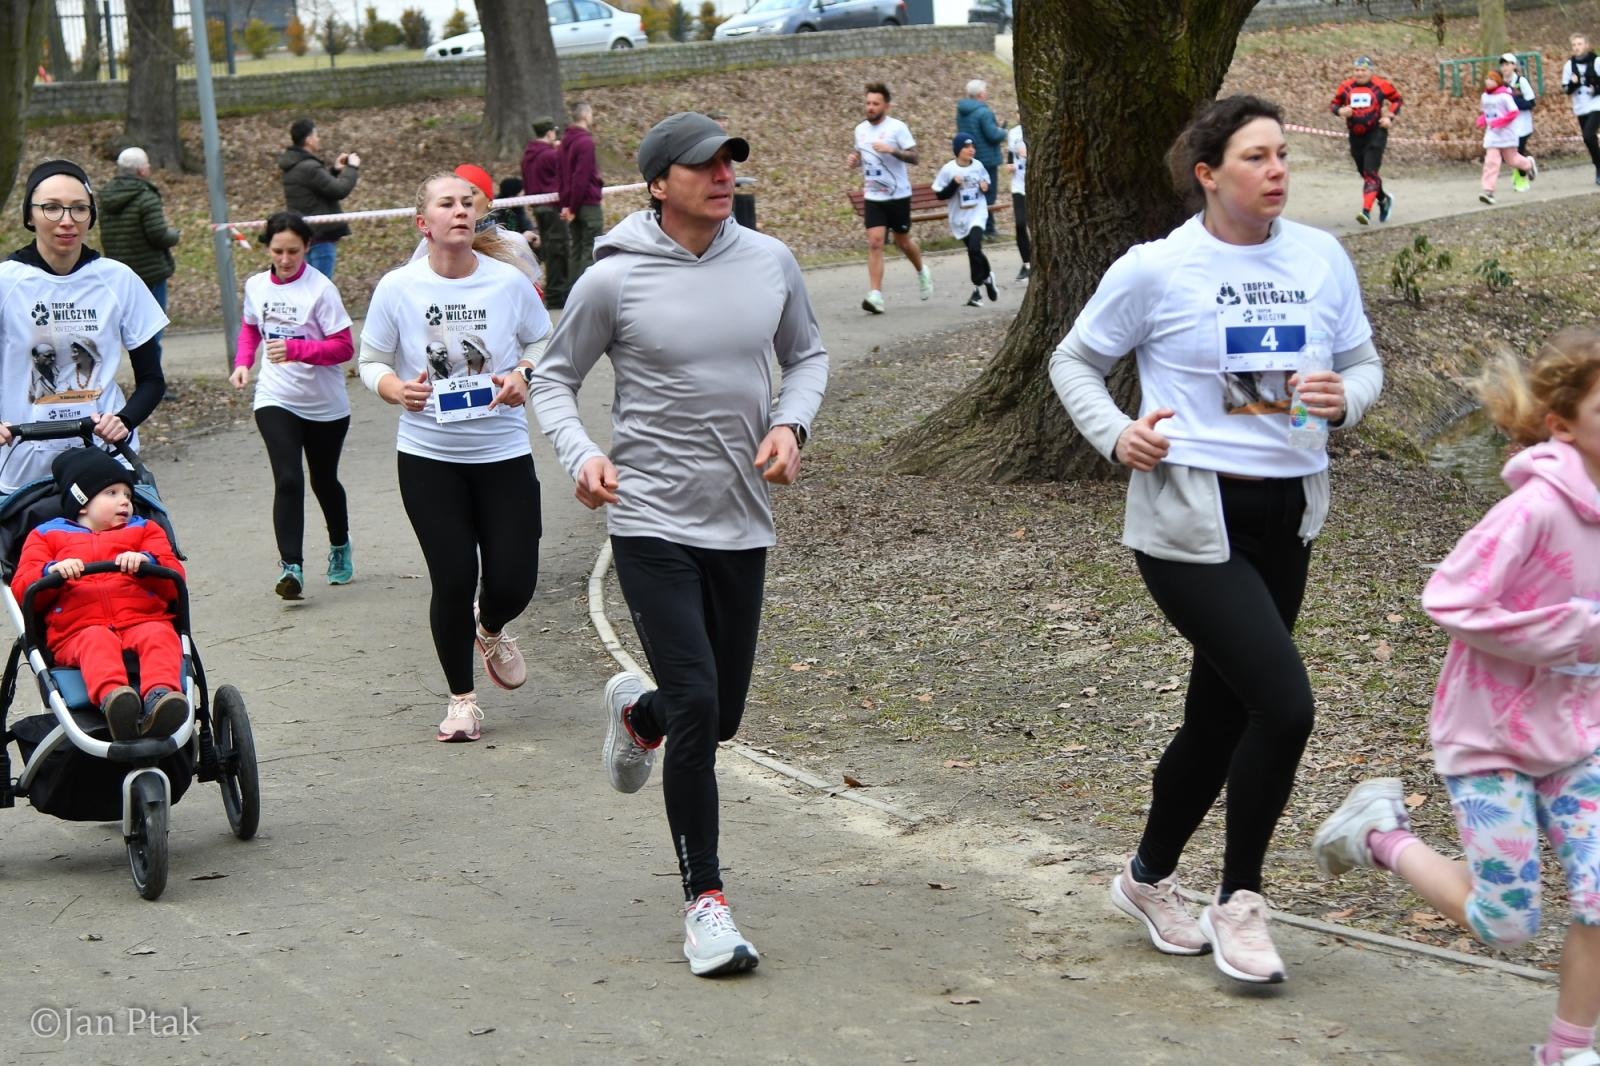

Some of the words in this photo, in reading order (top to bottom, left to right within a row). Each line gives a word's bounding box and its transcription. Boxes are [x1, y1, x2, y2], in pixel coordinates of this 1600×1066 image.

[1242, 282, 1274, 291] TROPEM
[1245, 290, 1306, 305] WILCZYM
[53, 309, 97, 320] WILCZYM
[445, 309, 487, 320] WILCZYM
[1260, 327, 1279, 351] 4
[462, 392, 472, 407] 1
